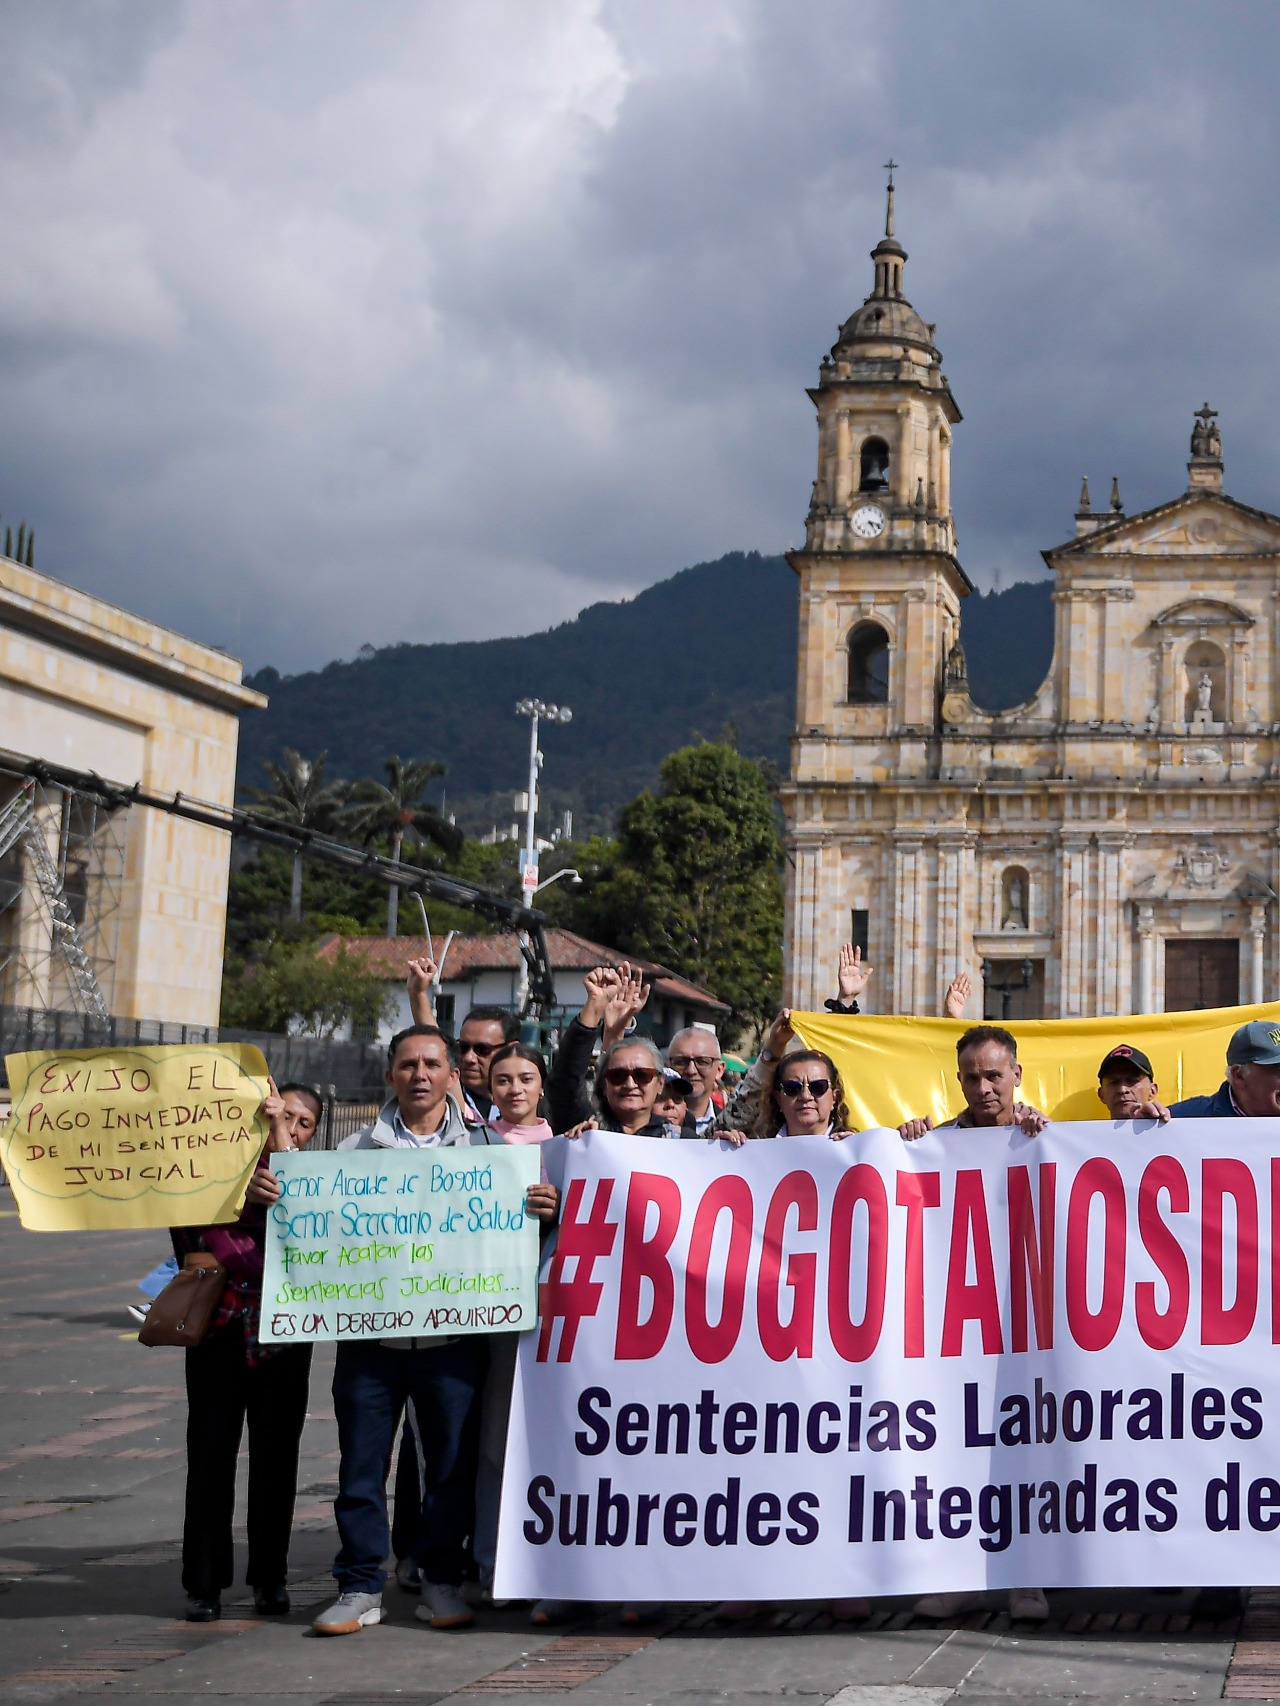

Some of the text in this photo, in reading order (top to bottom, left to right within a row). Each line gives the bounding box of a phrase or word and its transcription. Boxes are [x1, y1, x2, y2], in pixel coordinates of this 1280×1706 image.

[40, 1060, 237, 1094] EXIJO EL
[27, 1099, 243, 1134] PAGO INMEDIATO
[26, 1126, 250, 1161] DE MI SENTENCIA
[64, 1159, 205, 1185] JUDICIAL
[331, 1168, 389, 1197] Alcalde
[396, 1174, 419, 1195] de
[431, 1164, 492, 1193] Bogotá
[341, 1202, 432, 1237] Secretario
[439, 1206, 464, 1233] de
[468, 1197, 526, 1232] Salud
[282, 1240, 435, 1274] Favor Acatar las
[271, 1312, 297, 1337] ES
[336, 1309, 414, 1336] DERECHO
[423, 1303, 523, 1330] ADQUIRIDO
[574, 1385, 938, 1456] Sentencias
[964, 1372, 1264, 1448] Laborales
[522, 1474, 820, 1547] Subredes
[847, 1463, 1178, 1553] Integradas
